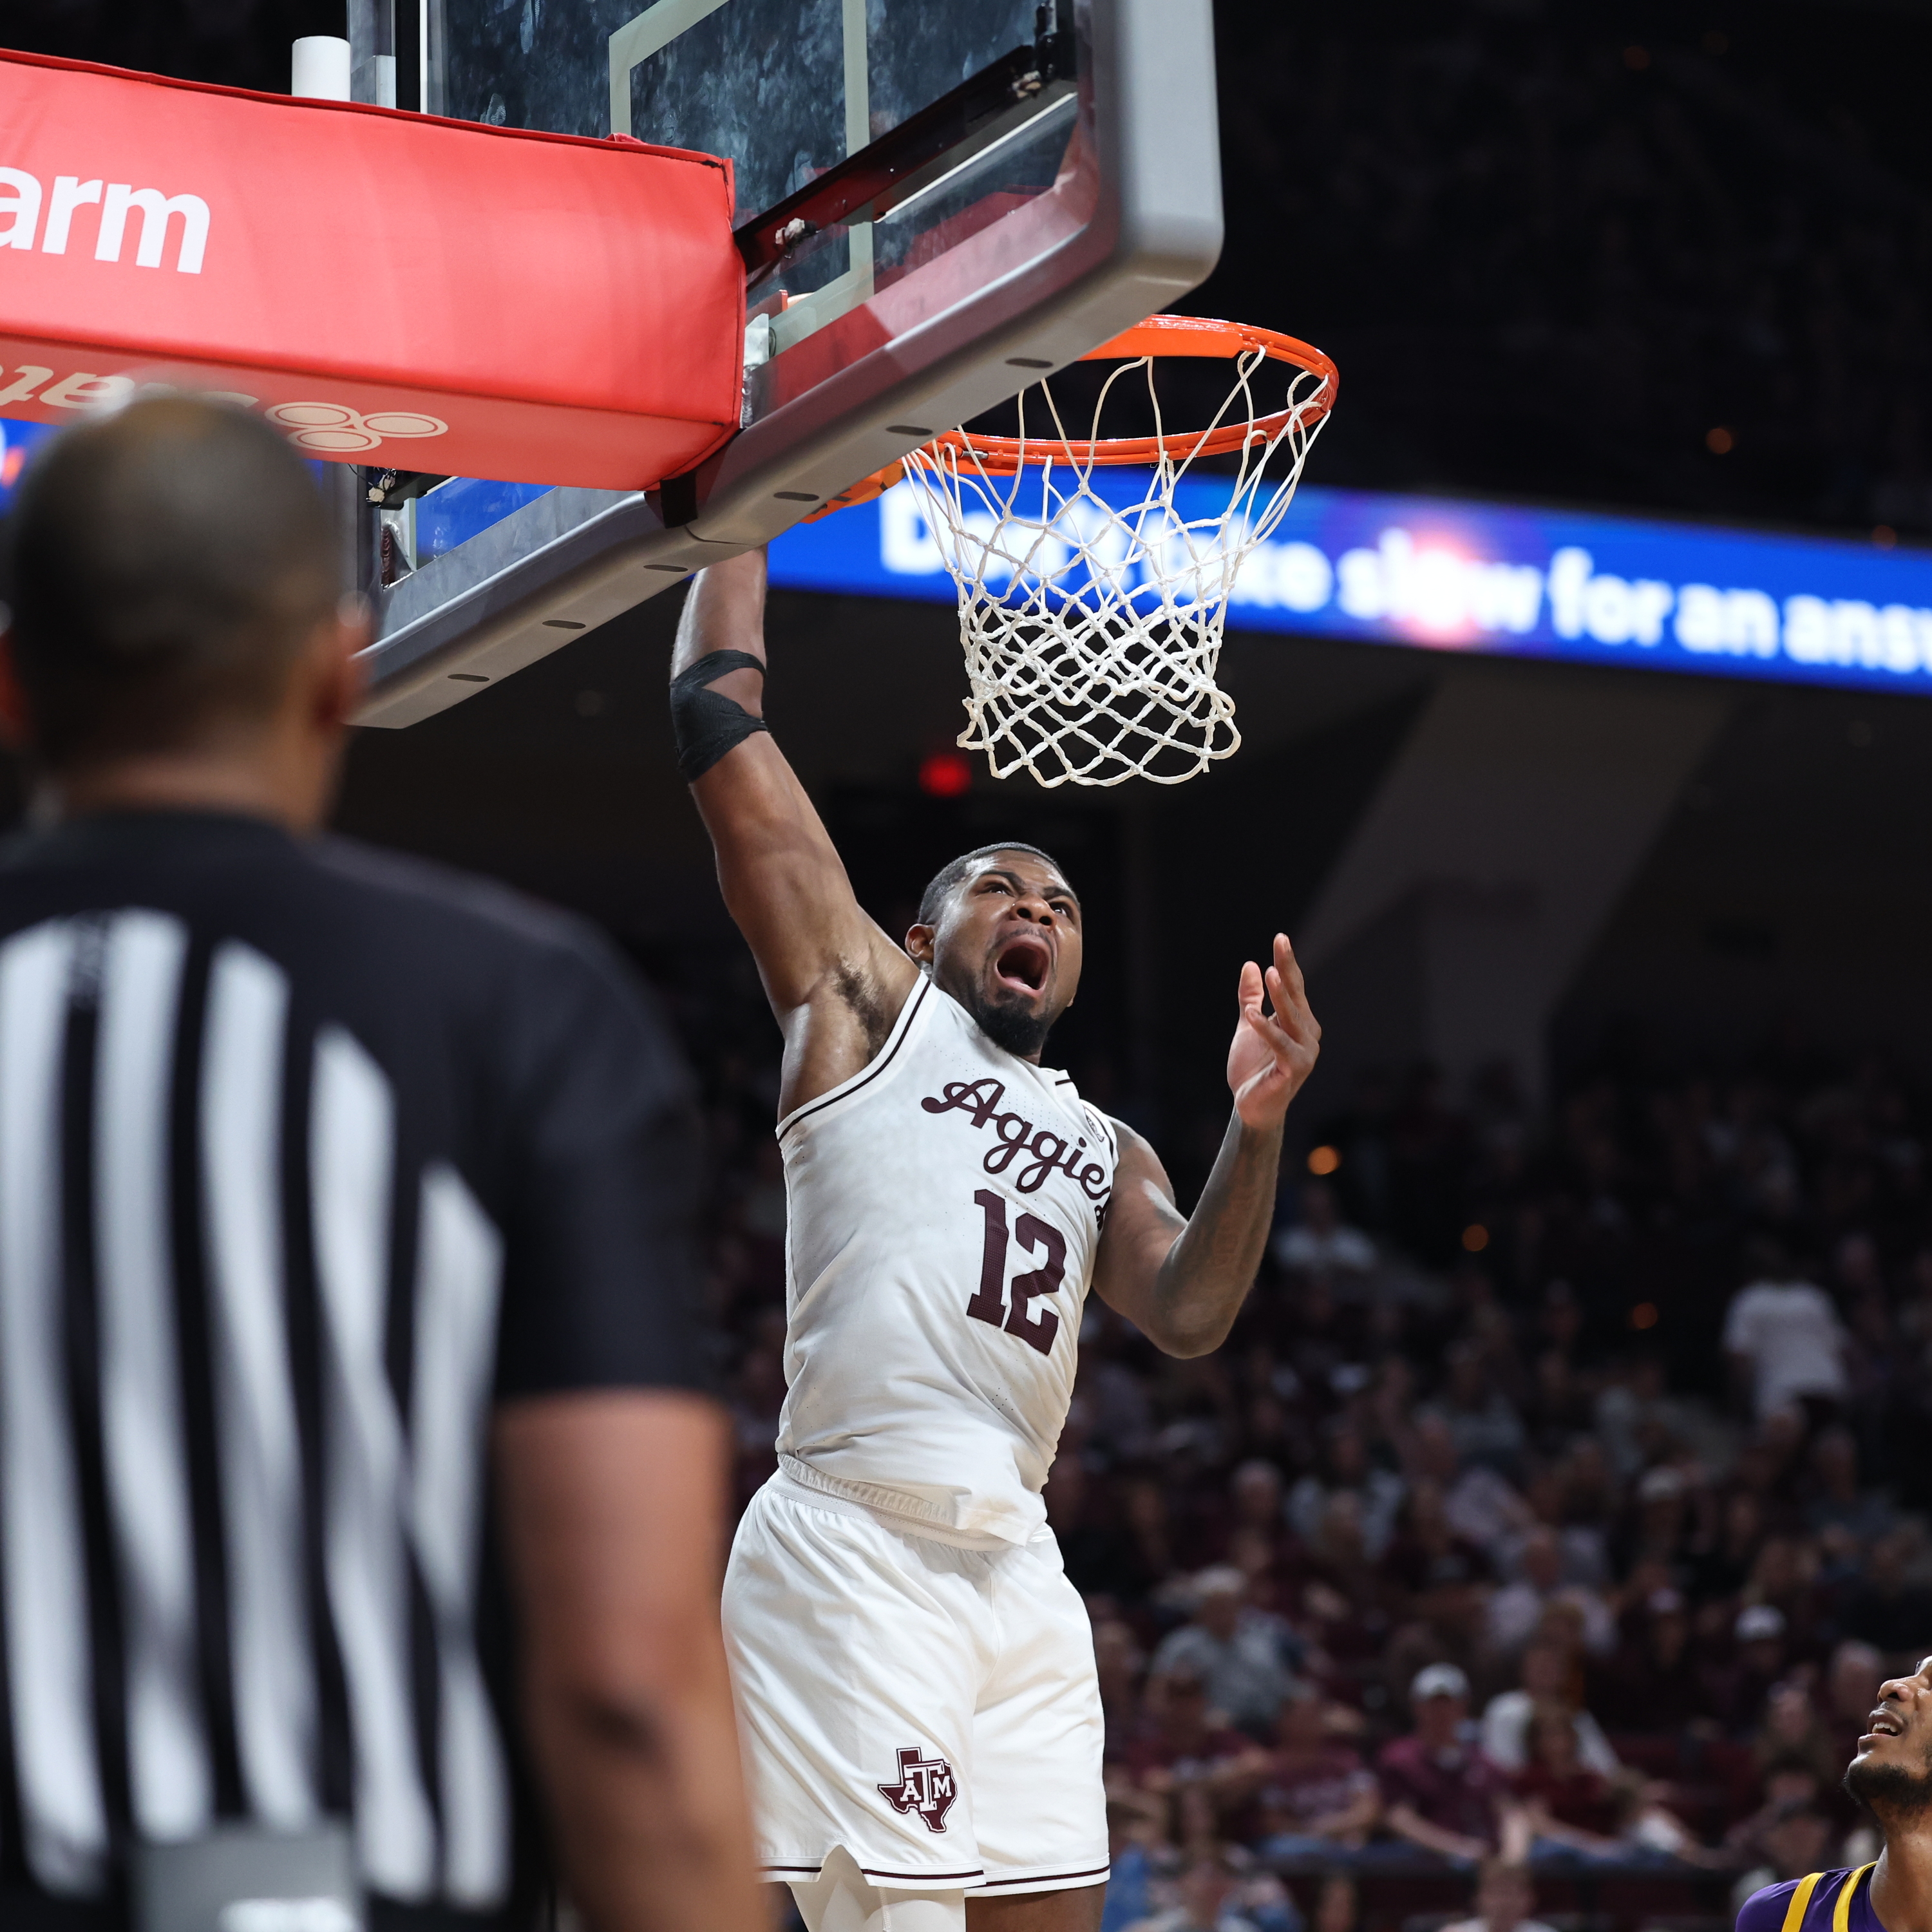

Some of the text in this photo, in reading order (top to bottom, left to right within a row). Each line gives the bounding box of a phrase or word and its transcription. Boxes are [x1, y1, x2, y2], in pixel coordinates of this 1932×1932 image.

[1549, 546, 1672, 647] for
[1676, 583, 1779, 659] an
[966, 1188, 1067, 1356] 12
